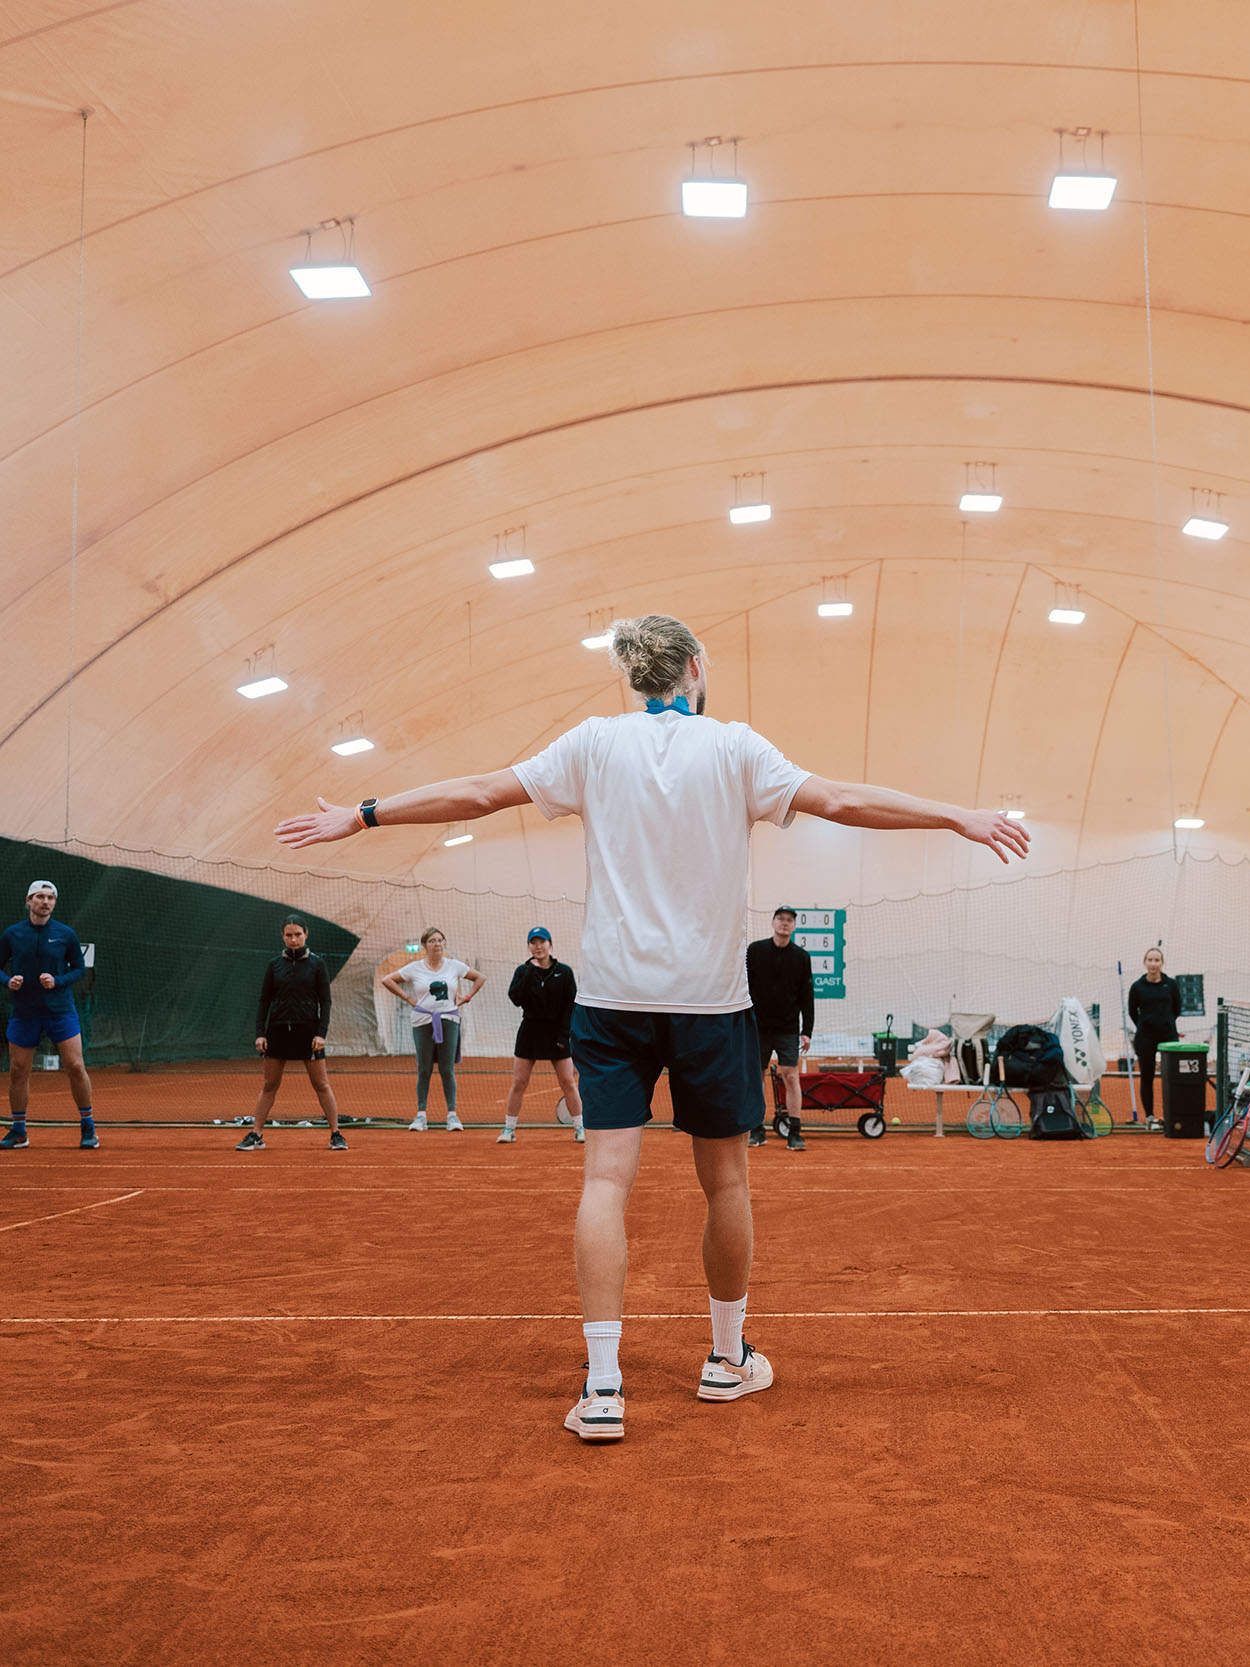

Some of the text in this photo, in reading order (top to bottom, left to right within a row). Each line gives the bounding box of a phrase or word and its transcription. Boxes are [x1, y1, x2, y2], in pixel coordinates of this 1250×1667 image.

[801, 913, 830, 926] 0 0
[801, 936, 829, 948] 3 6
[822, 959, 828, 970] 4
[814, 977, 841, 986] GAST
[1068, 1010, 1084, 1045] YONEX
